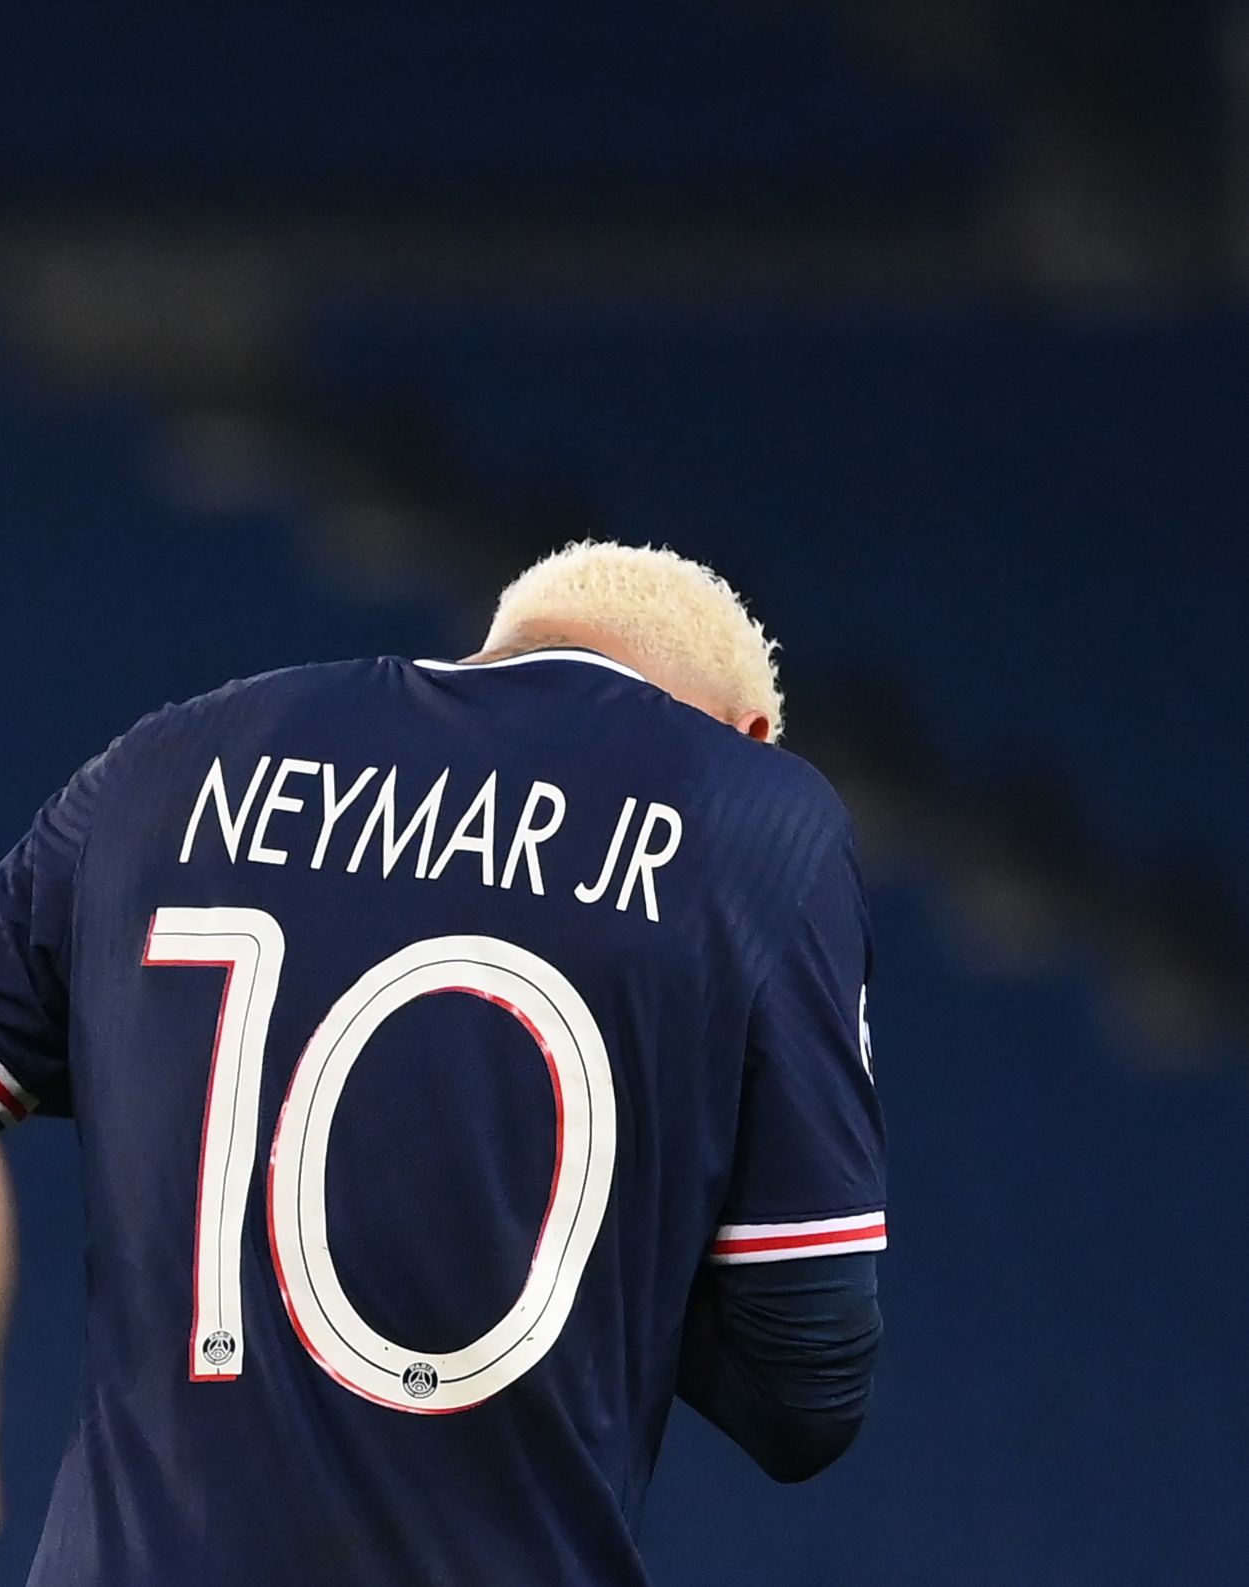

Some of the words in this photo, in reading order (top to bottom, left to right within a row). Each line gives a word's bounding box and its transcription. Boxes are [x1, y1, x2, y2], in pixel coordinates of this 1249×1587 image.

[179, 755, 567, 897] NEYMAR
[573, 796, 683, 924] JR
[143, 906, 617, 1416] 10
